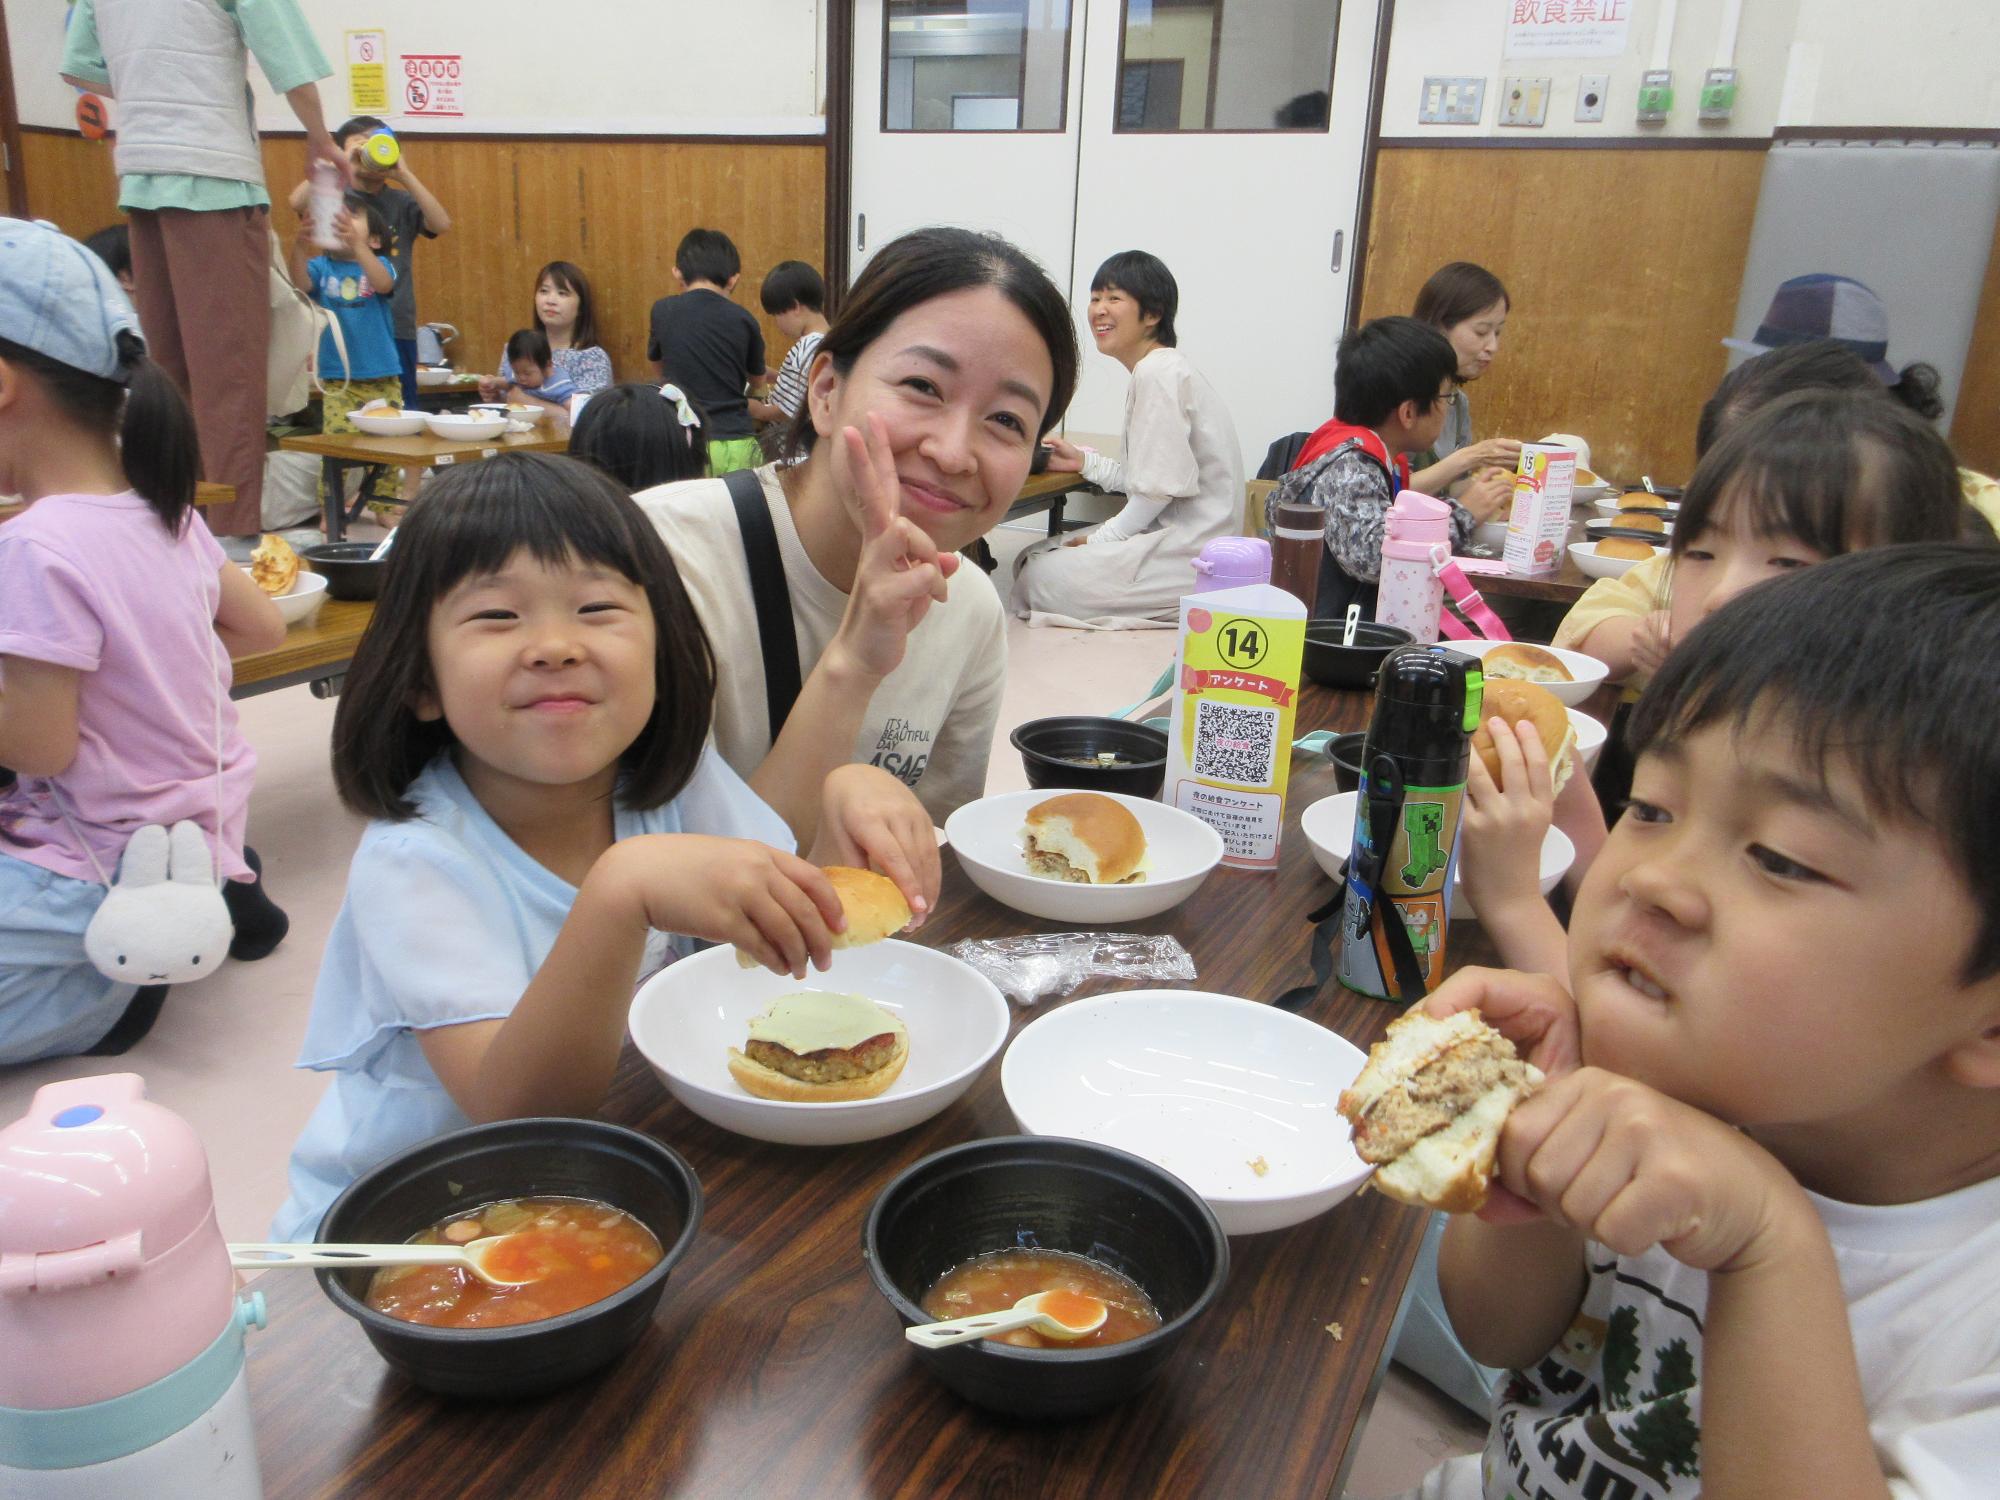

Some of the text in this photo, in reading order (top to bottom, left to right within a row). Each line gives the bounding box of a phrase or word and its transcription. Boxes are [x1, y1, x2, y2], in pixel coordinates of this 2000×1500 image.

[1512, 0, 1627, 25] 飲食禁止
[1524, 455, 1534, 471] 15
[1225, 627, 1259, 660] 14
[1209, 674, 1269, 692] アンケート
[903, 719, 910, 731] A
[881, 729, 931, 742] BEAUTIFUL
[876, 738, 900, 751] DAY
[1215, 737, 1250, 751] 夜の給食
[1192, 790, 1264, 808] 夜の給食アンケート
[1214, 827, 1273, 840] ご記入いただけると
